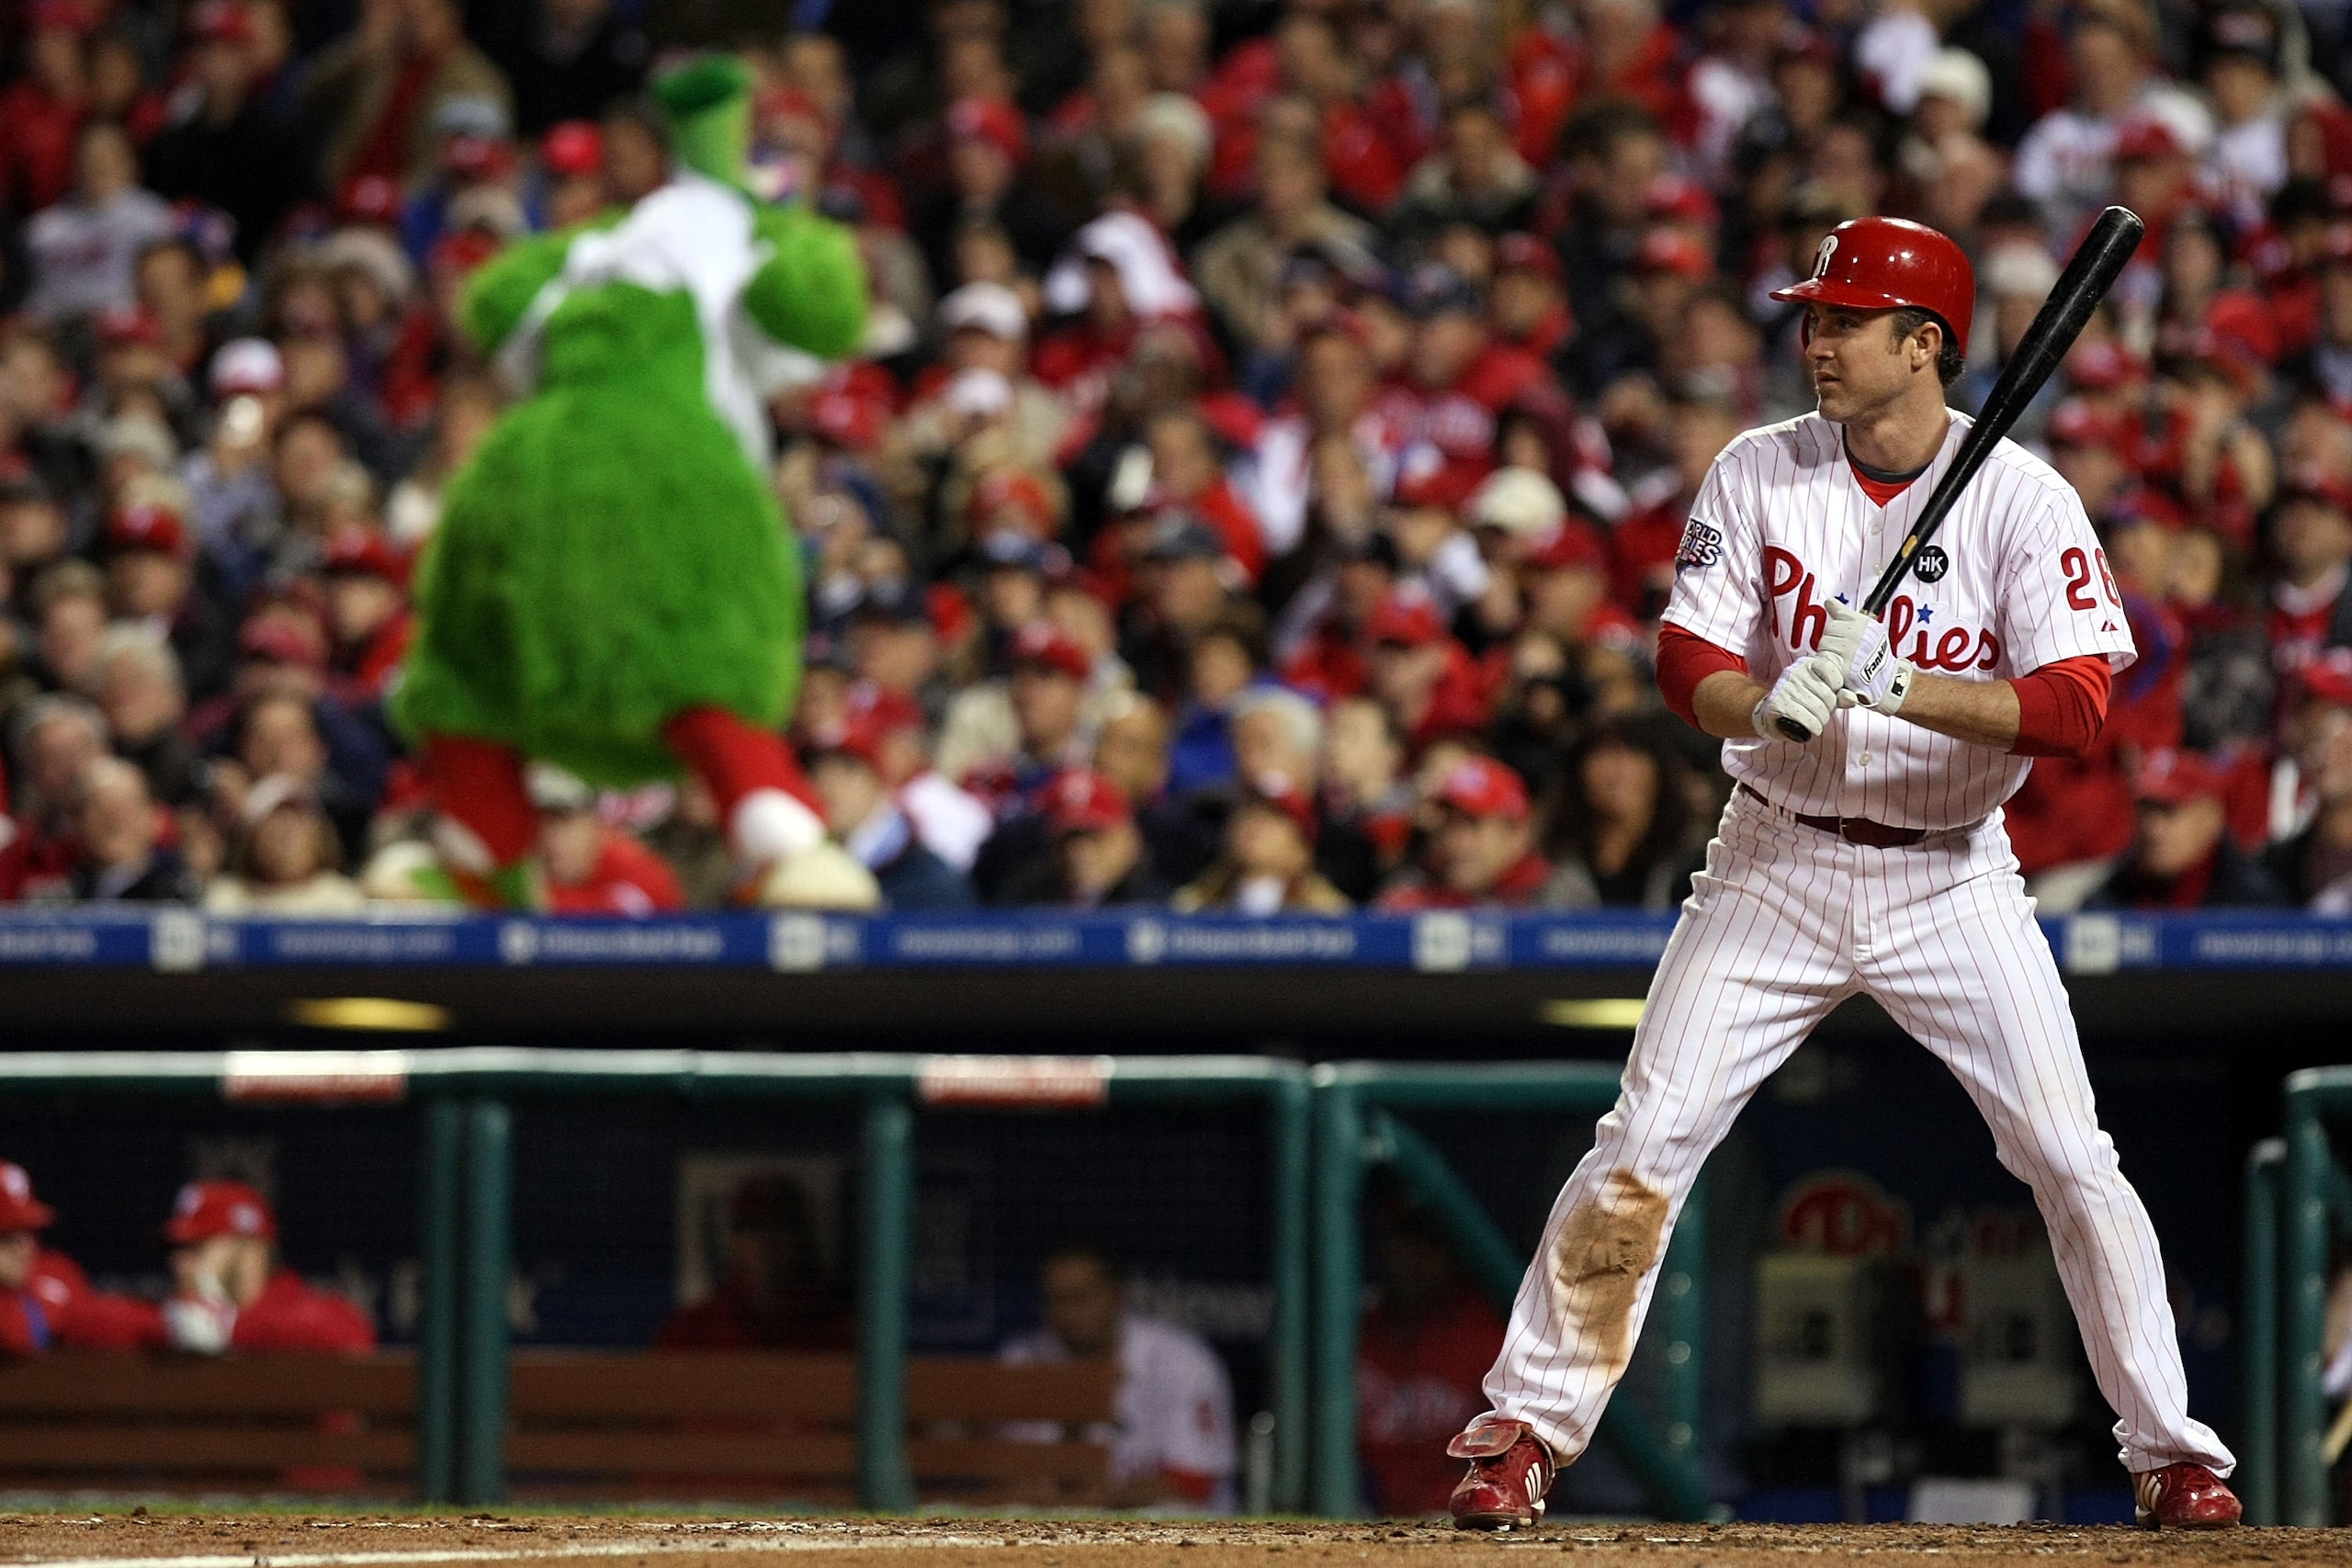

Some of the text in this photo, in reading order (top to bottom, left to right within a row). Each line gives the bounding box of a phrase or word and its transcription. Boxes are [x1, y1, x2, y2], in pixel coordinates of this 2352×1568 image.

[1688, 520, 1721, 546] ORLD
[1681, 535, 1720, 566] ERIES
[1917, 556, 1944, 573] HK
[1765, 546, 2000, 671] Phlies
